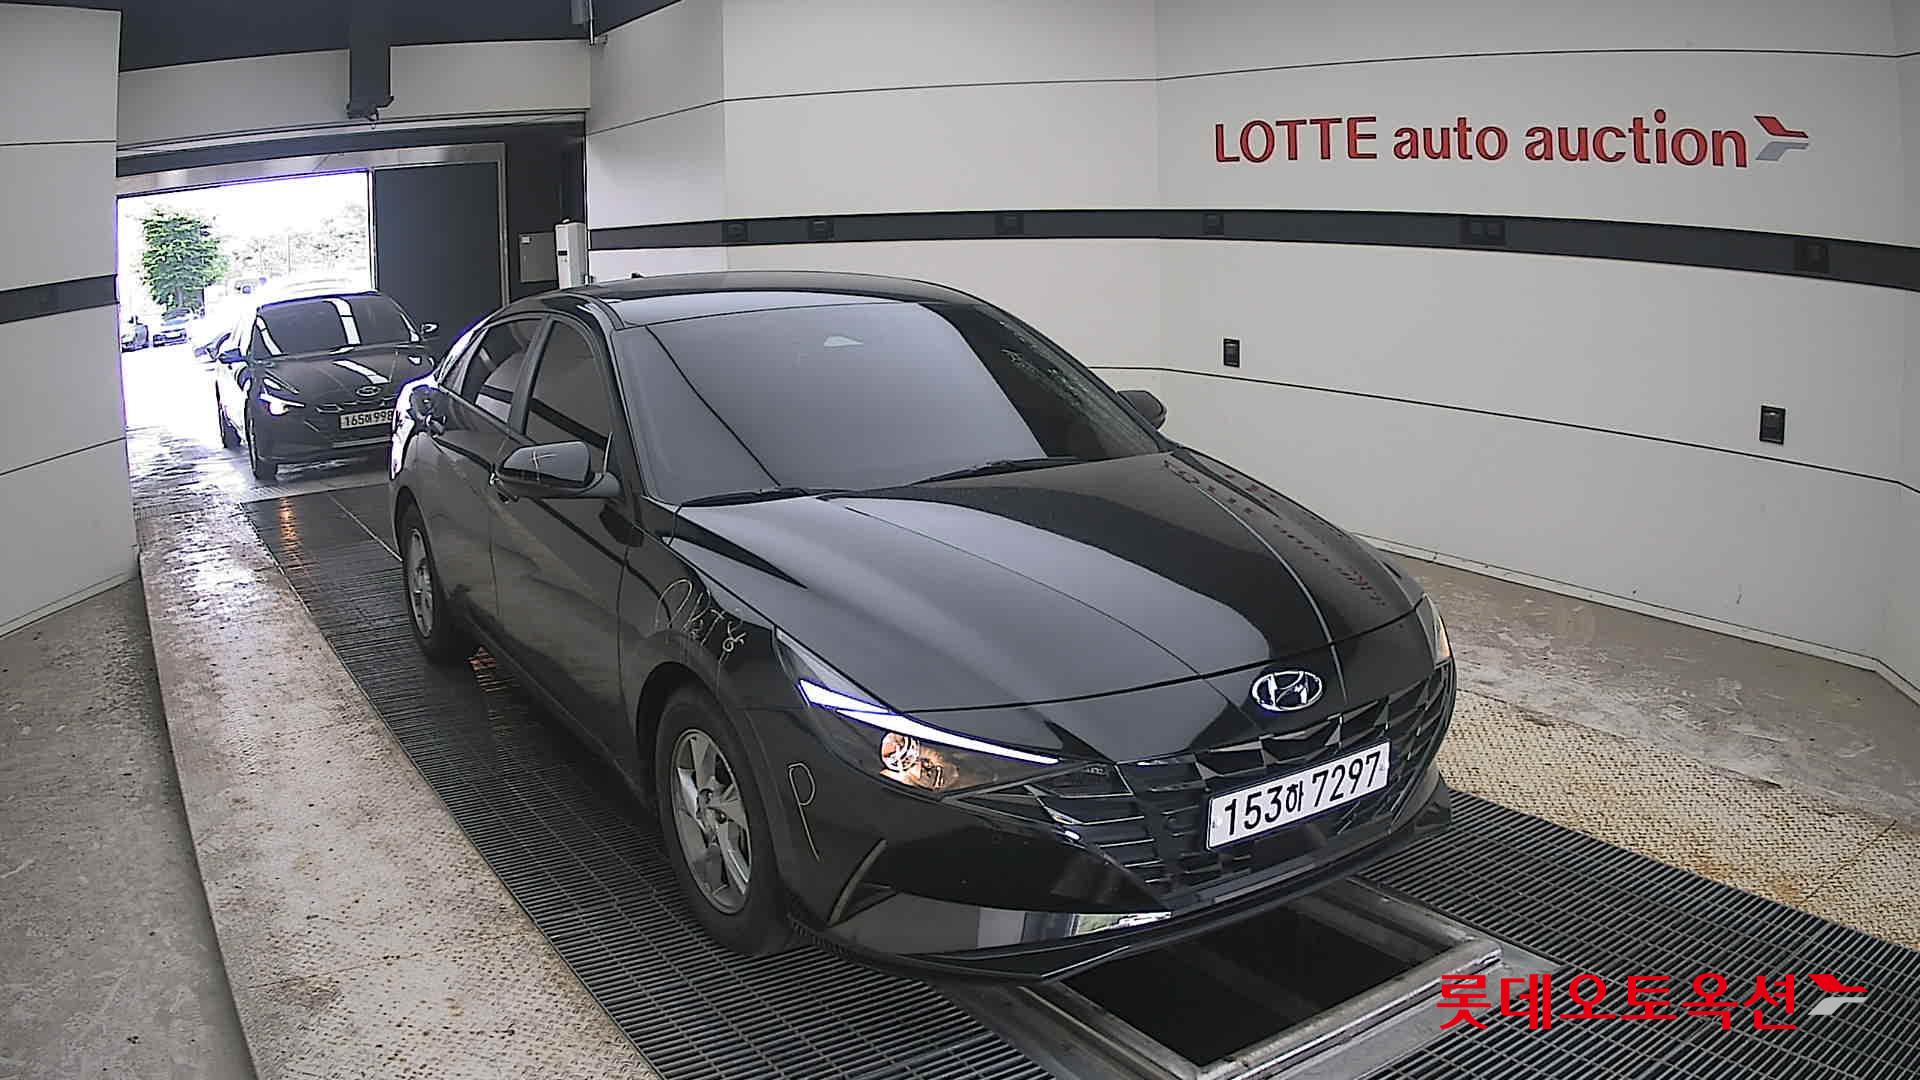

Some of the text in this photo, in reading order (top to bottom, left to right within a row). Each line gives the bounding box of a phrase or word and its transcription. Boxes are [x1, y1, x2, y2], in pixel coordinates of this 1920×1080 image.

[1214, 109, 1749, 169] LOTTE auto auction
[373, 410, 394, 422] 998
[1224, 751, 1381, 836] 153하 7297
